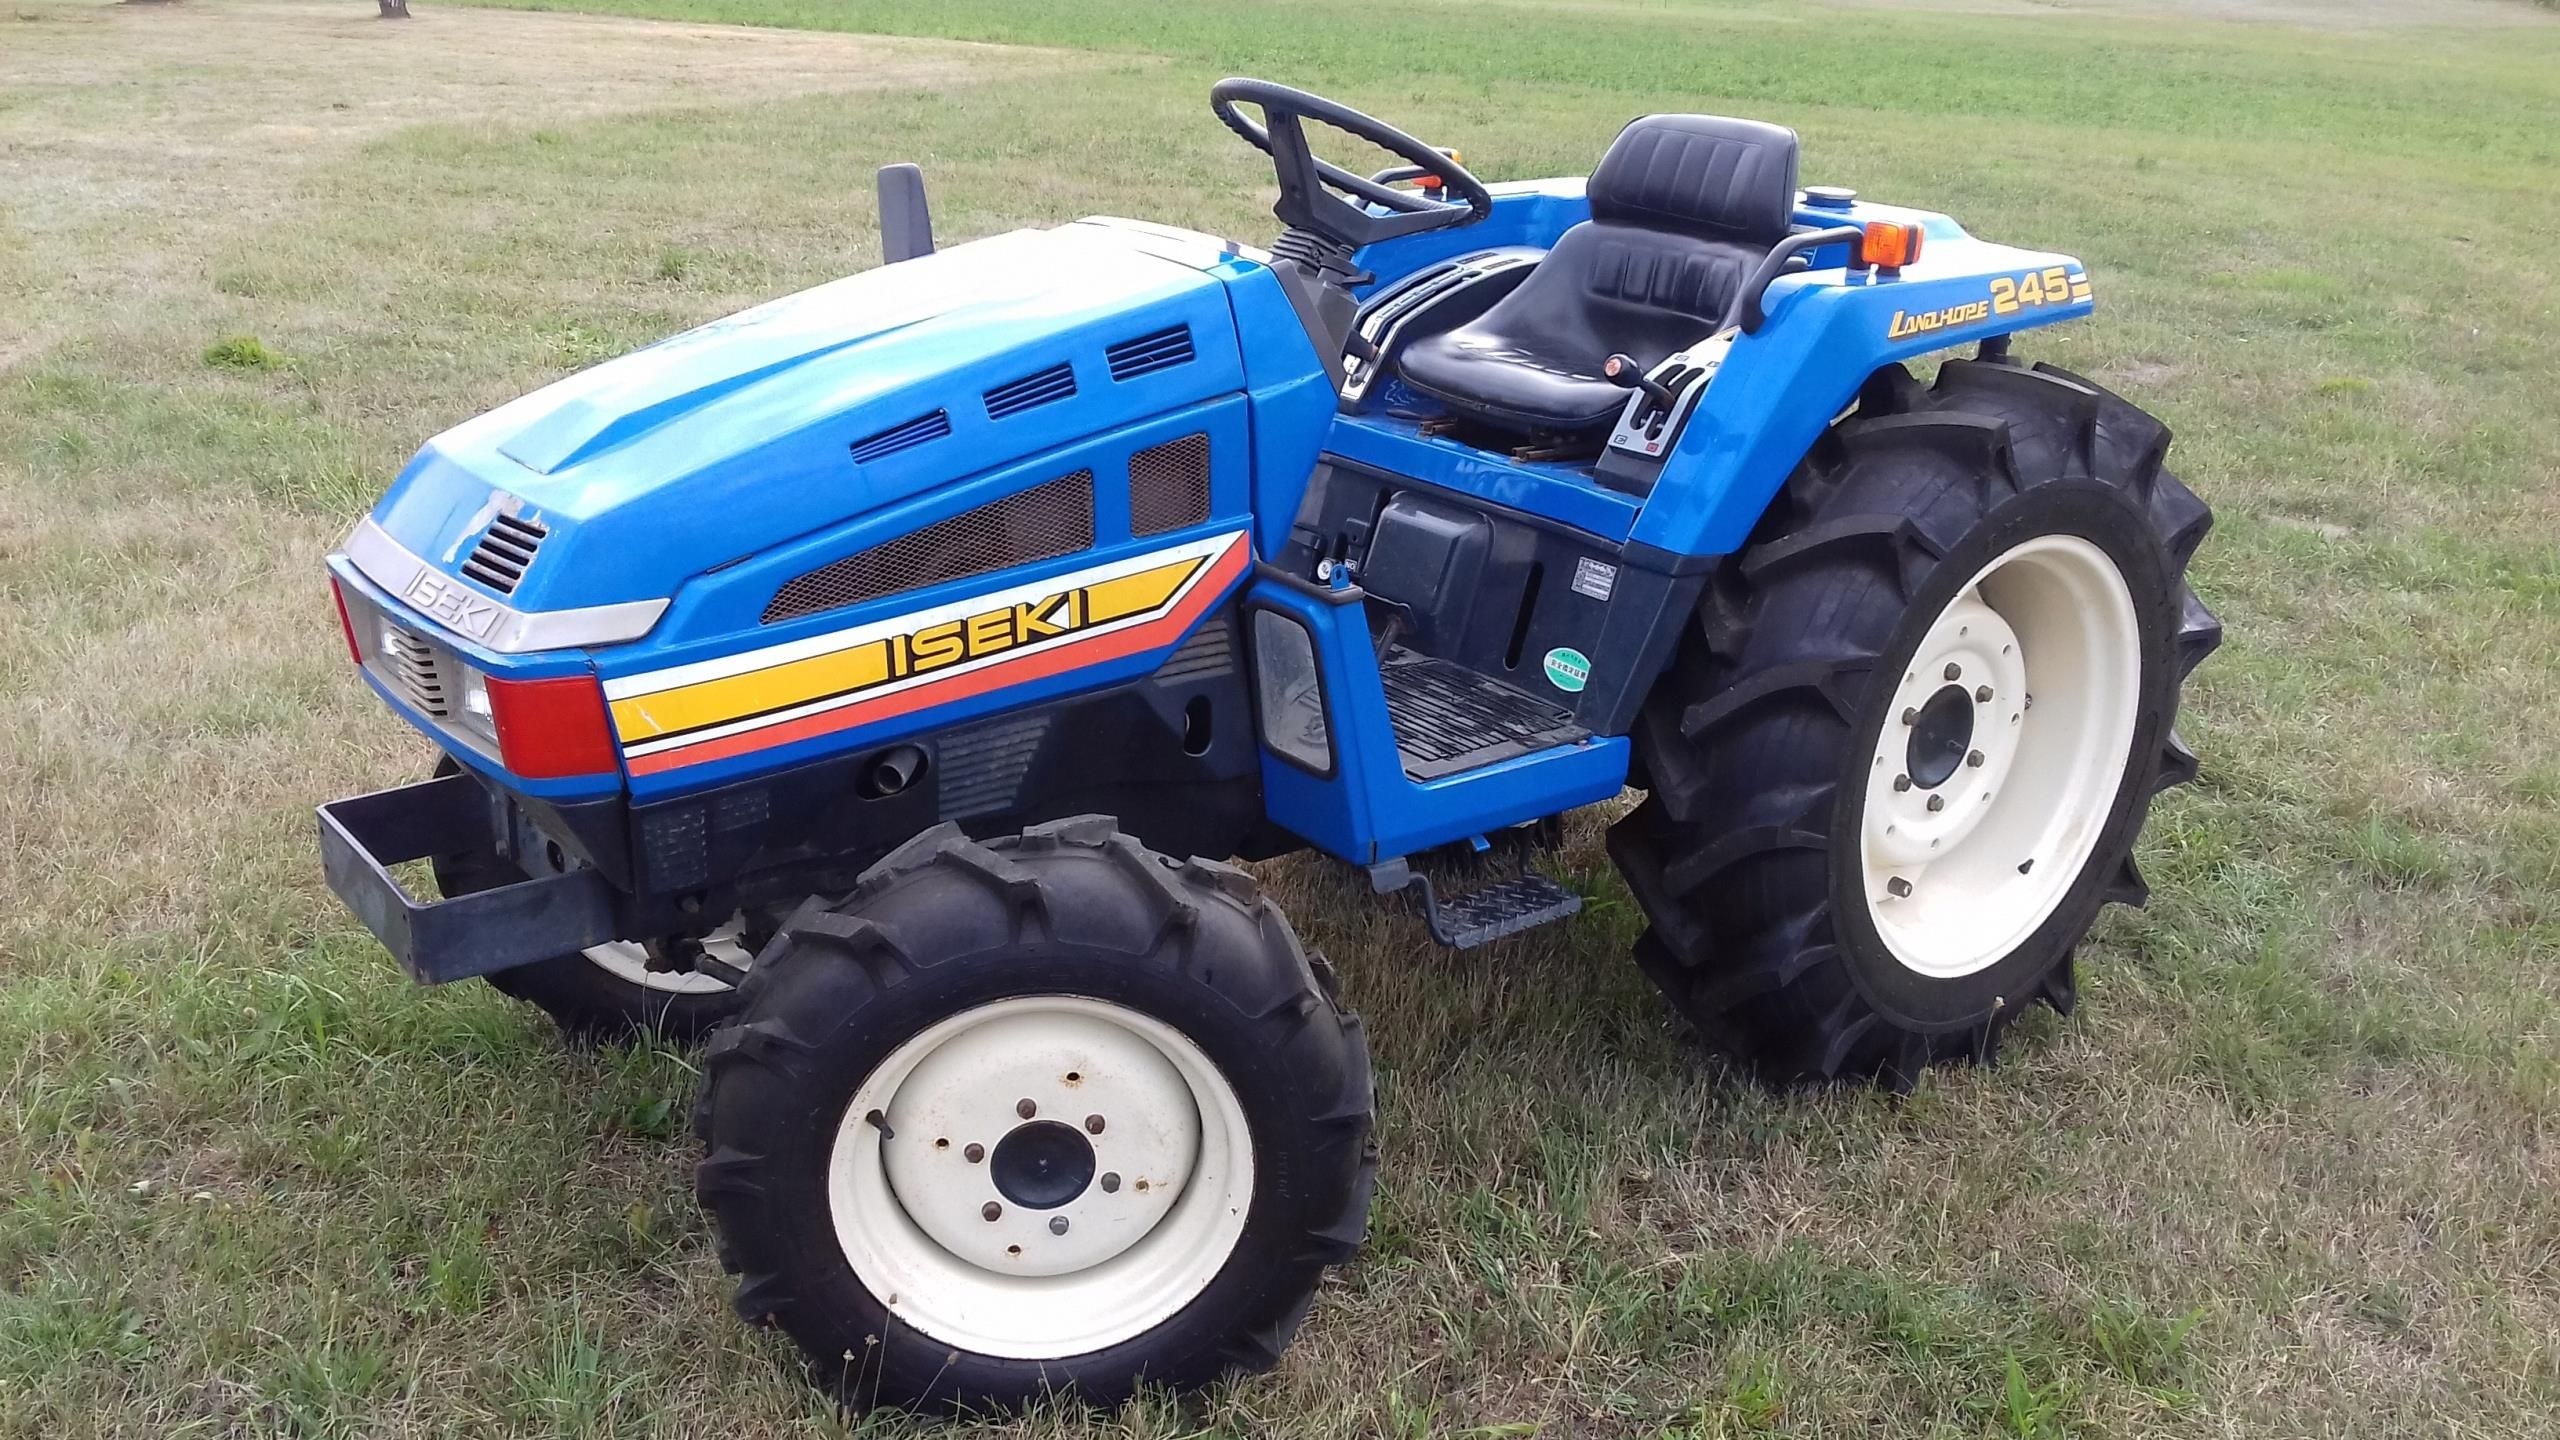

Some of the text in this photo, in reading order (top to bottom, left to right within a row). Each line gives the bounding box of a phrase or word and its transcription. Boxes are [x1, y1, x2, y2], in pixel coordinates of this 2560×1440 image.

[1990, 266, 2069, 315] 245
[402, 565, 509, 644] ISEKI
[892, 588, 1083, 678] ISEKI
